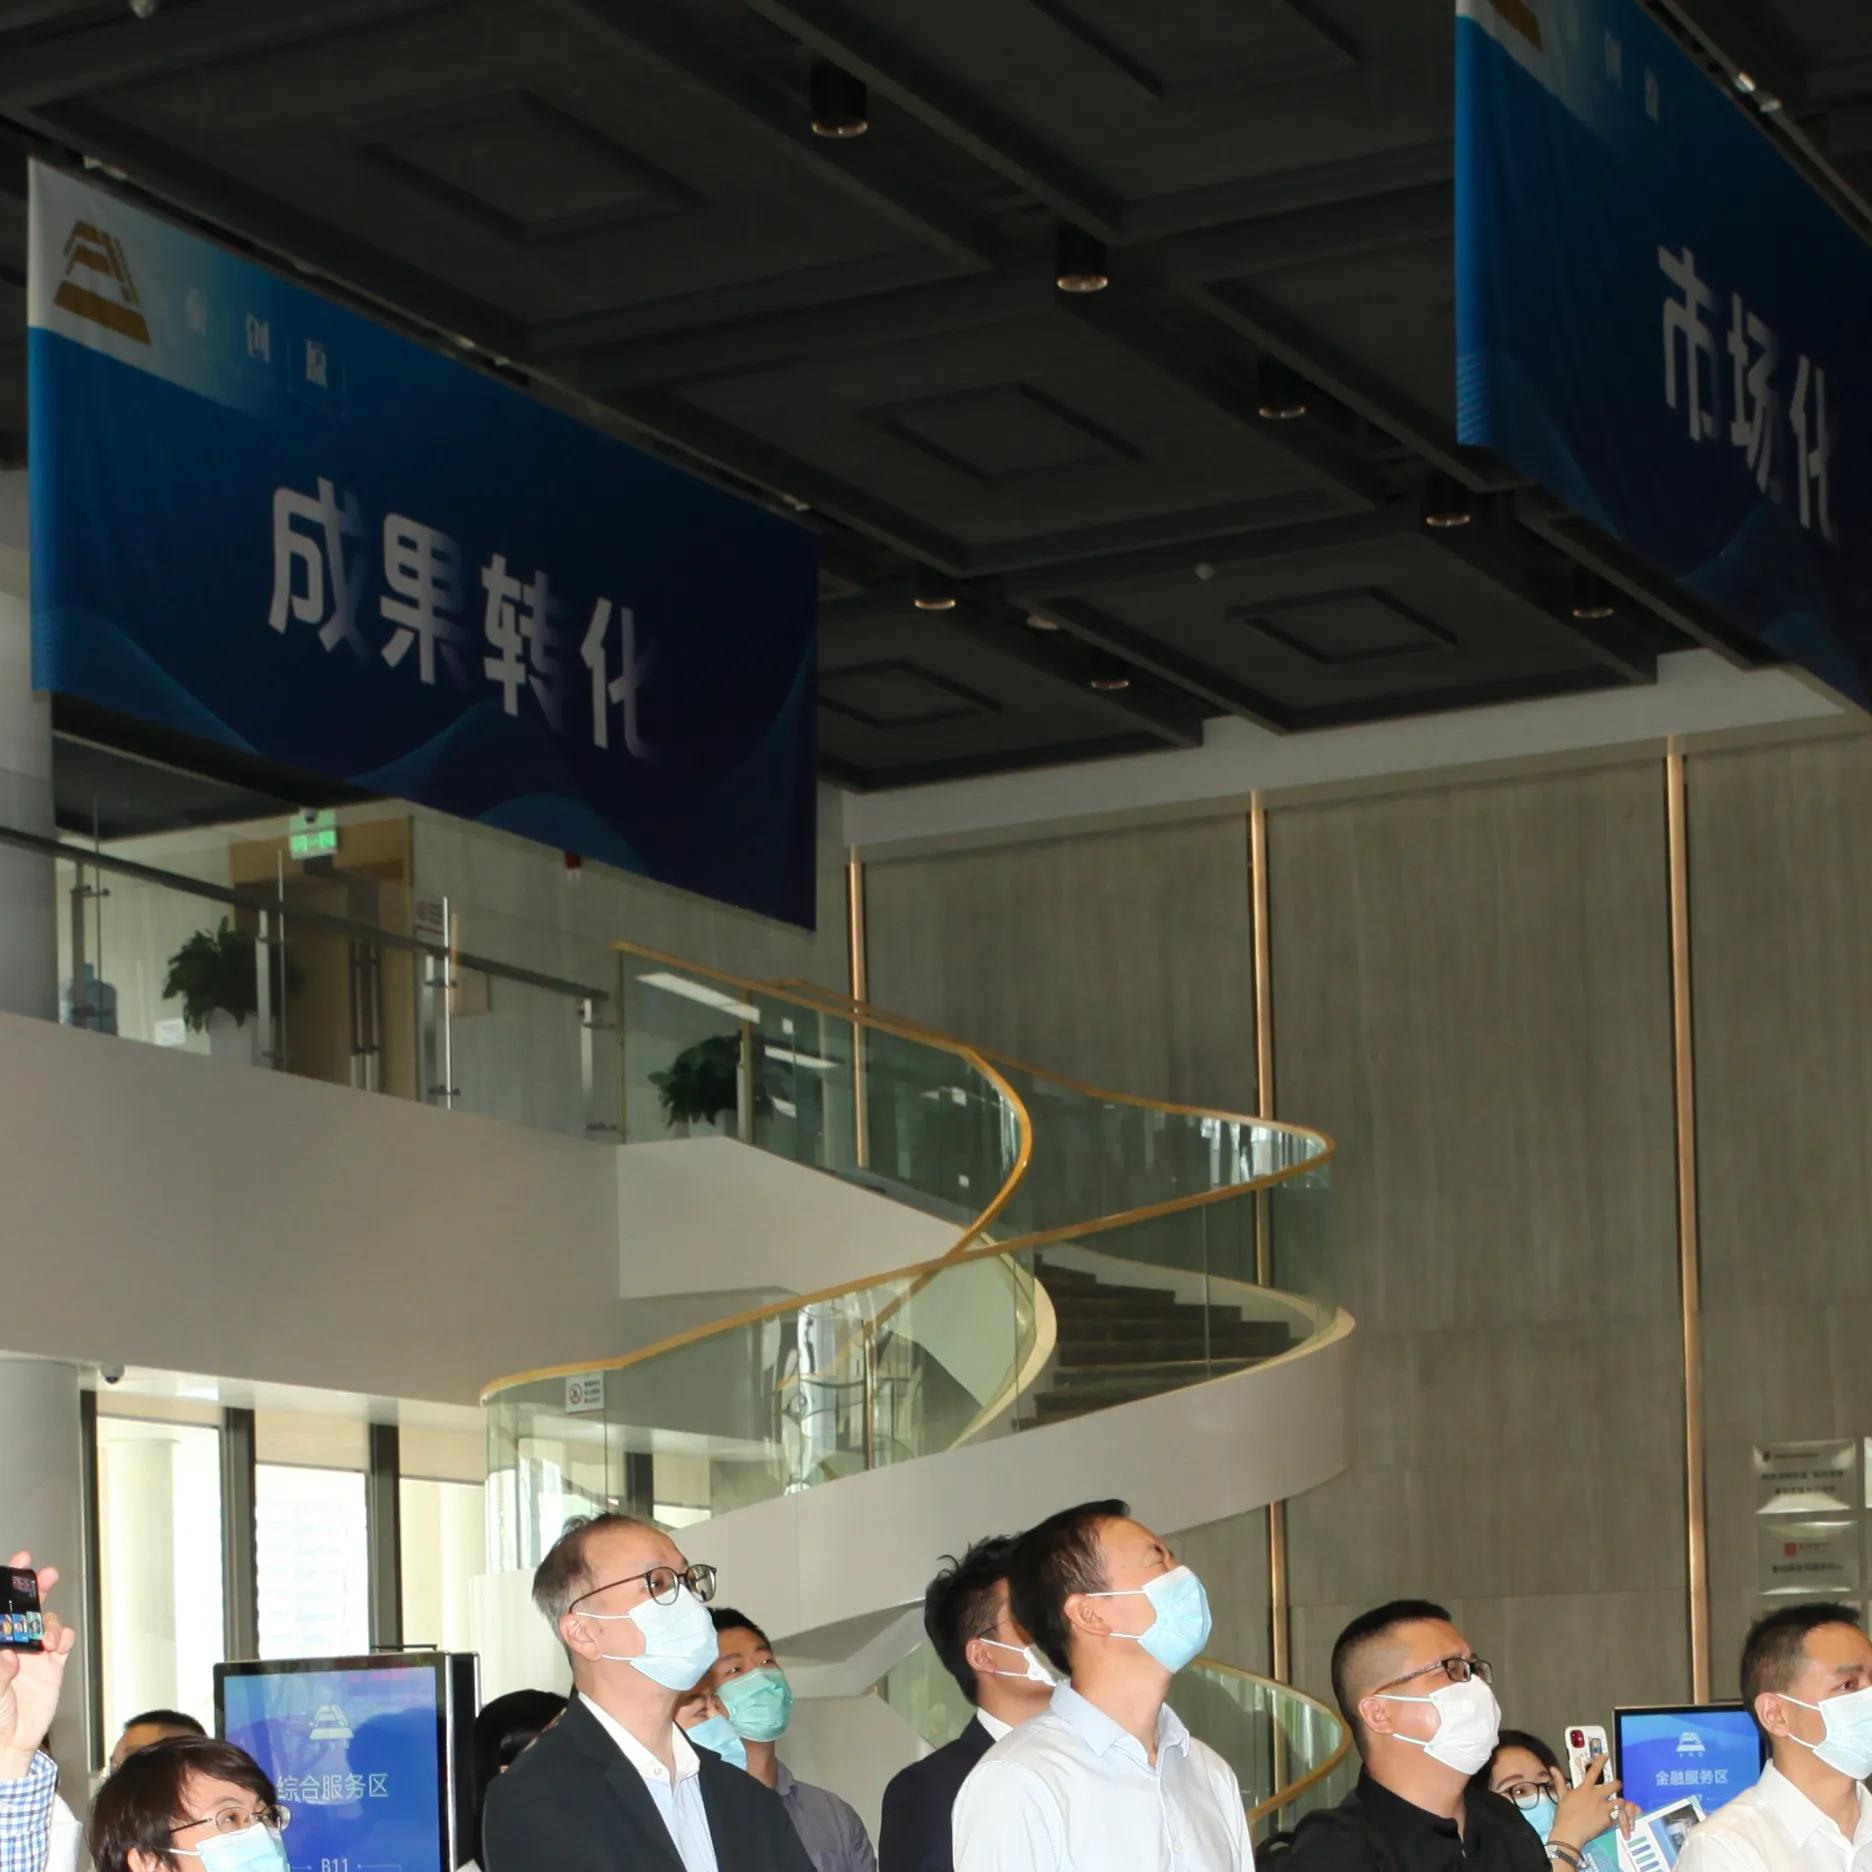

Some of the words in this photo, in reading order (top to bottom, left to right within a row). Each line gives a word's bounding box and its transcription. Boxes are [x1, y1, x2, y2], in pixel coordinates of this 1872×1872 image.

[1658, 245, 1839, 545] 市场化
[268, 475, 658, 763] 成果转化
[277, 1772, 390, 1802] 综合服务区
[1655, 1769, 1729, 1787] 金融服务区
